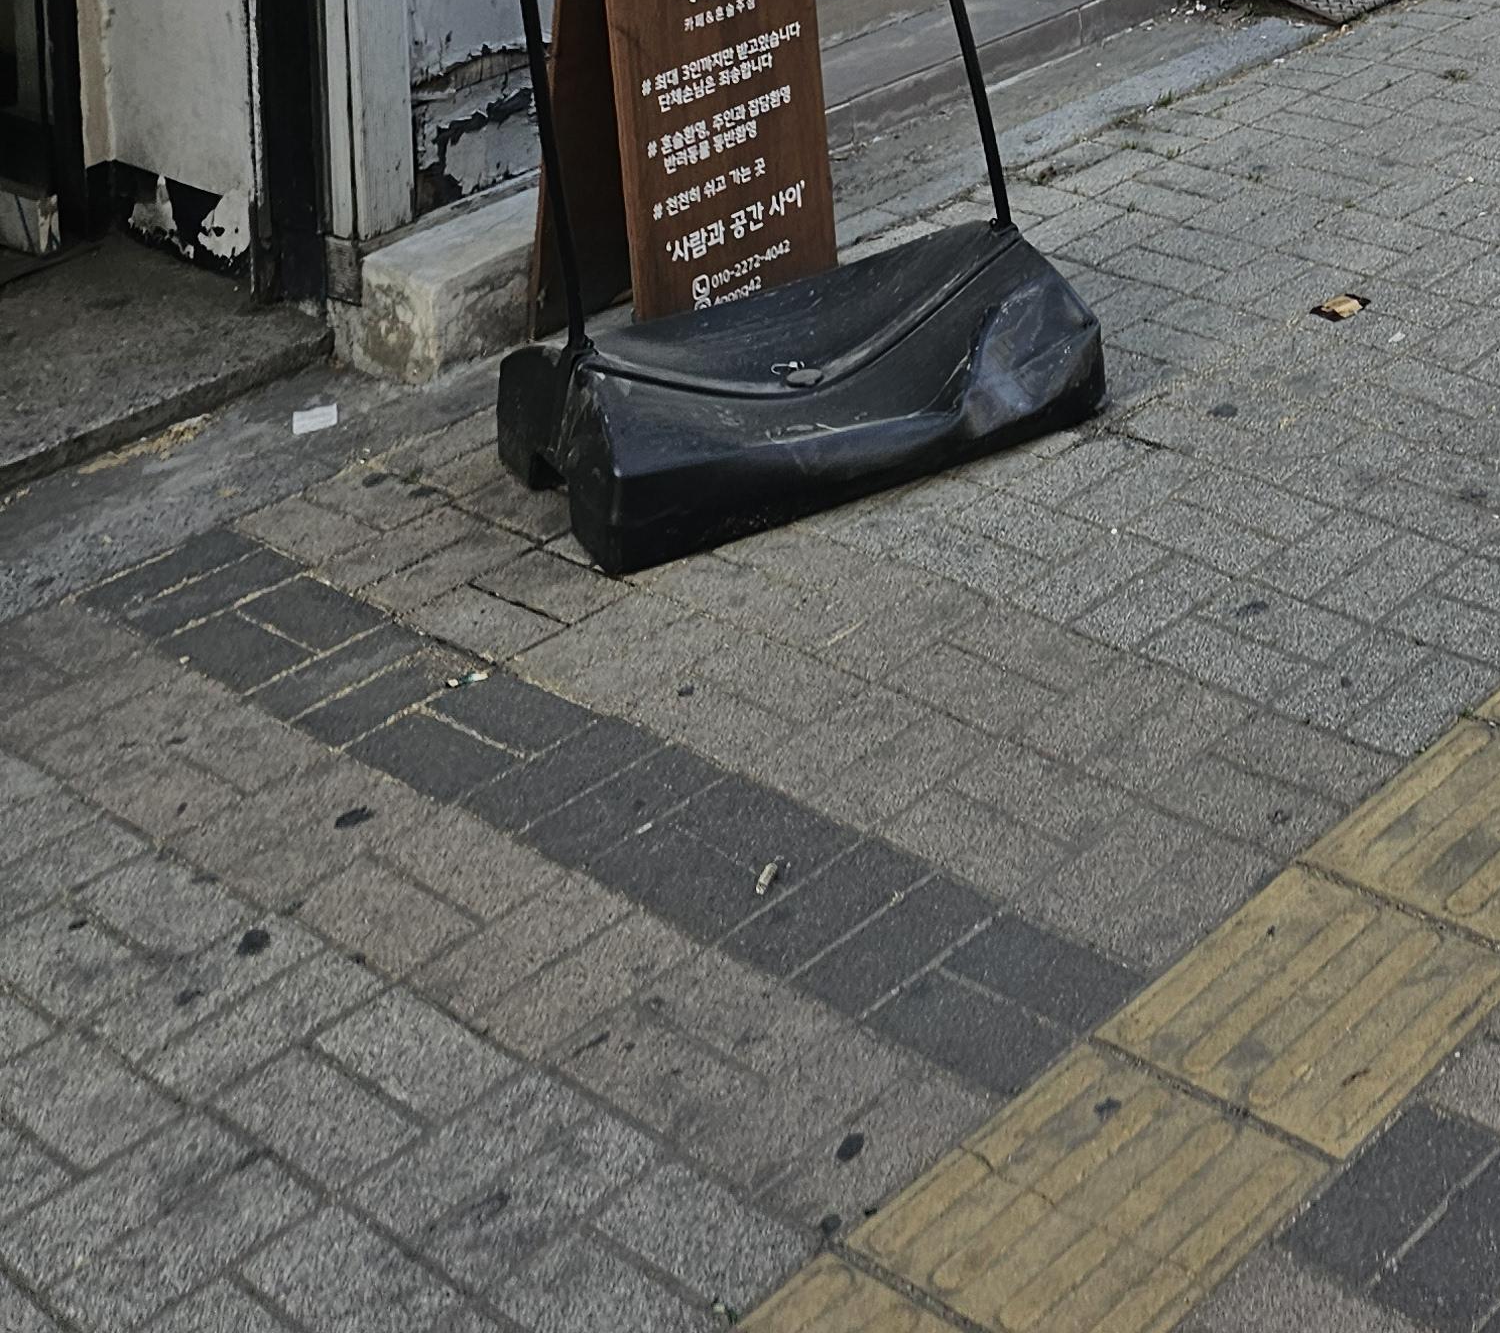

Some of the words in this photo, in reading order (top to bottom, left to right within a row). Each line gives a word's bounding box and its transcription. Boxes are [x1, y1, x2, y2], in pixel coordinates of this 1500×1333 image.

[654, 68, 679, 92] 최대
[681, 46, 735, 81] 3인까지만
[737, 20, 801, 59] 받고있습니다
[658, 77, 716, 113] 단체손님은
[718, 52, 773, 87] 죄송합니다
[712, 107, 747, 132] 주인과
[748, 85, 792, 118] 잡담환영
[663, 140, 712, 174] 반려동물
[713, 119, 758, 154] 동반환영
[665, 185, 701, 217] 천천히
[703, 175, 727, 198] 쉬고
[729, 167, 752, 185] 가는
[754, 157, 766, 178] 곳
[729, 201, 765, 240] 공간
[710, 239, 792, 290] 010-2272-4042
